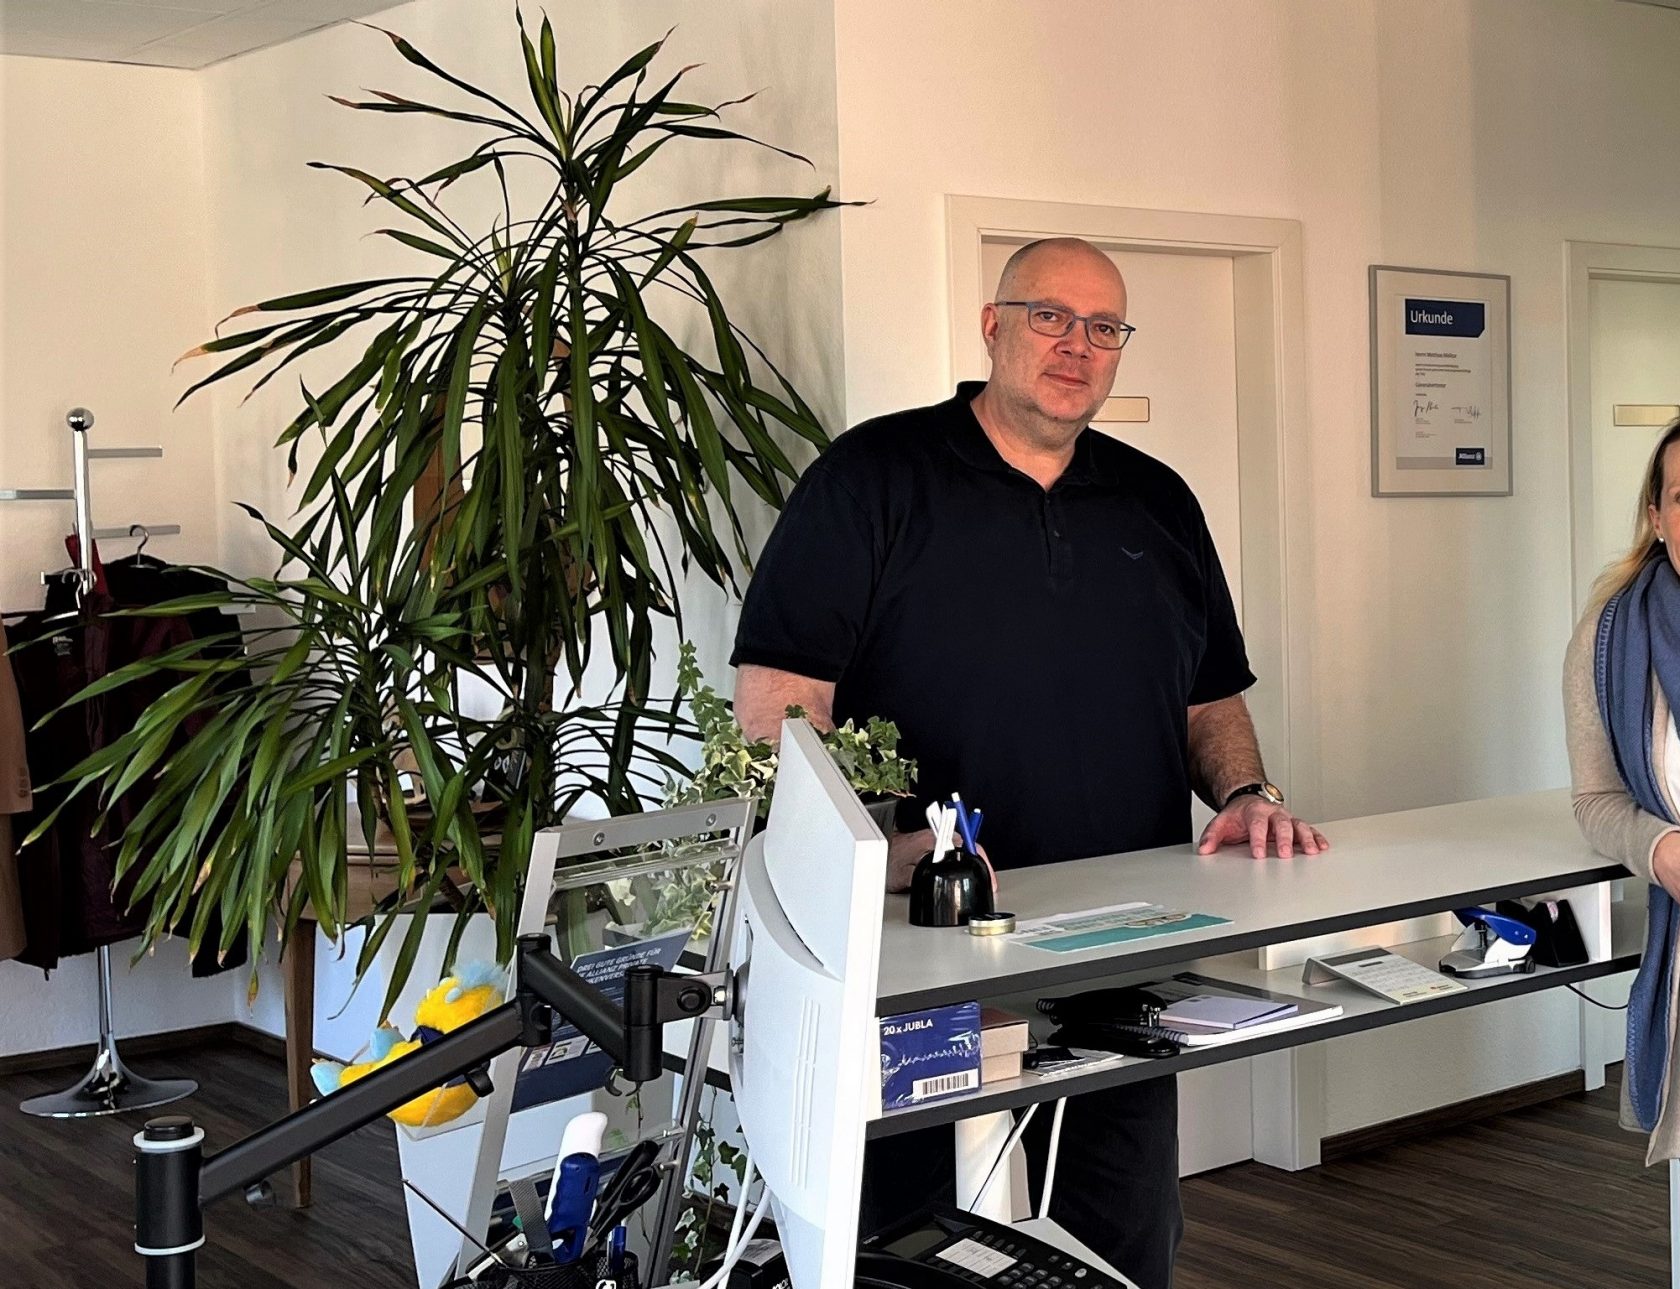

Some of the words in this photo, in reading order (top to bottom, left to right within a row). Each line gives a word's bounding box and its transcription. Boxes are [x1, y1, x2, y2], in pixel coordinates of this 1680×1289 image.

[1410, 309, 1454, 325] Urkunde
[595, 958, 616, 969] GUTE
[883, 1026, 896, 1036] 20
[903, 1018, 934, 1032] JUBLA
